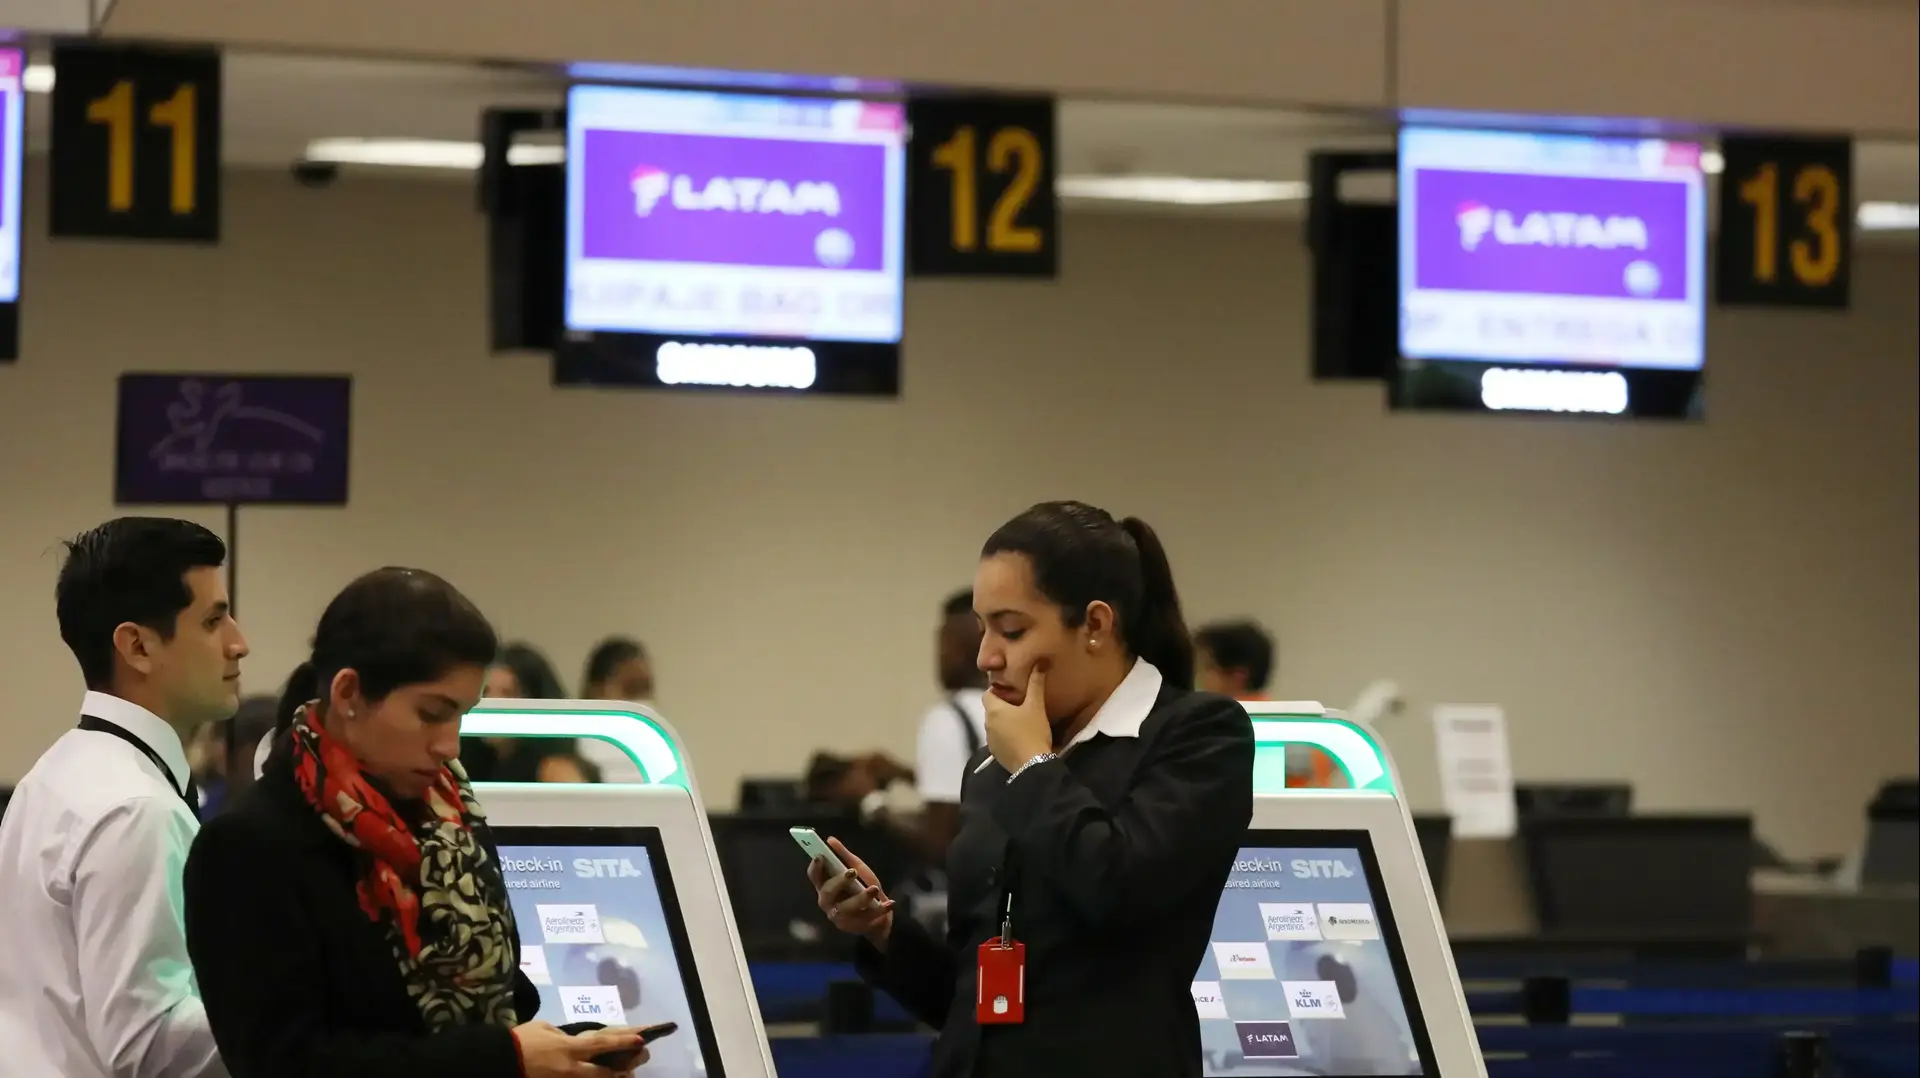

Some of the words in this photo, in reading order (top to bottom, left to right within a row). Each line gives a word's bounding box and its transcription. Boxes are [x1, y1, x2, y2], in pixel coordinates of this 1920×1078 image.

[88, 80, 196, 211] 11
[672, 174, 841, 216] LATAM
[932, 125, 1042, 251] 12
[1493, 209, 1649, 250] LATAM
[1739, 162, 1840, 287] 13
[573, 858, 641, 878] SITA
[1291, 859, 1353, 878] SITA
[529, 879, 561, 888] airline
[1252, 879, 1280, 888] airline
[573, 1005, 602, 1015] KLM
[1295, 999, 1321, 1009] KLM
[1255, 1034, 1289, 1042] LATAM
